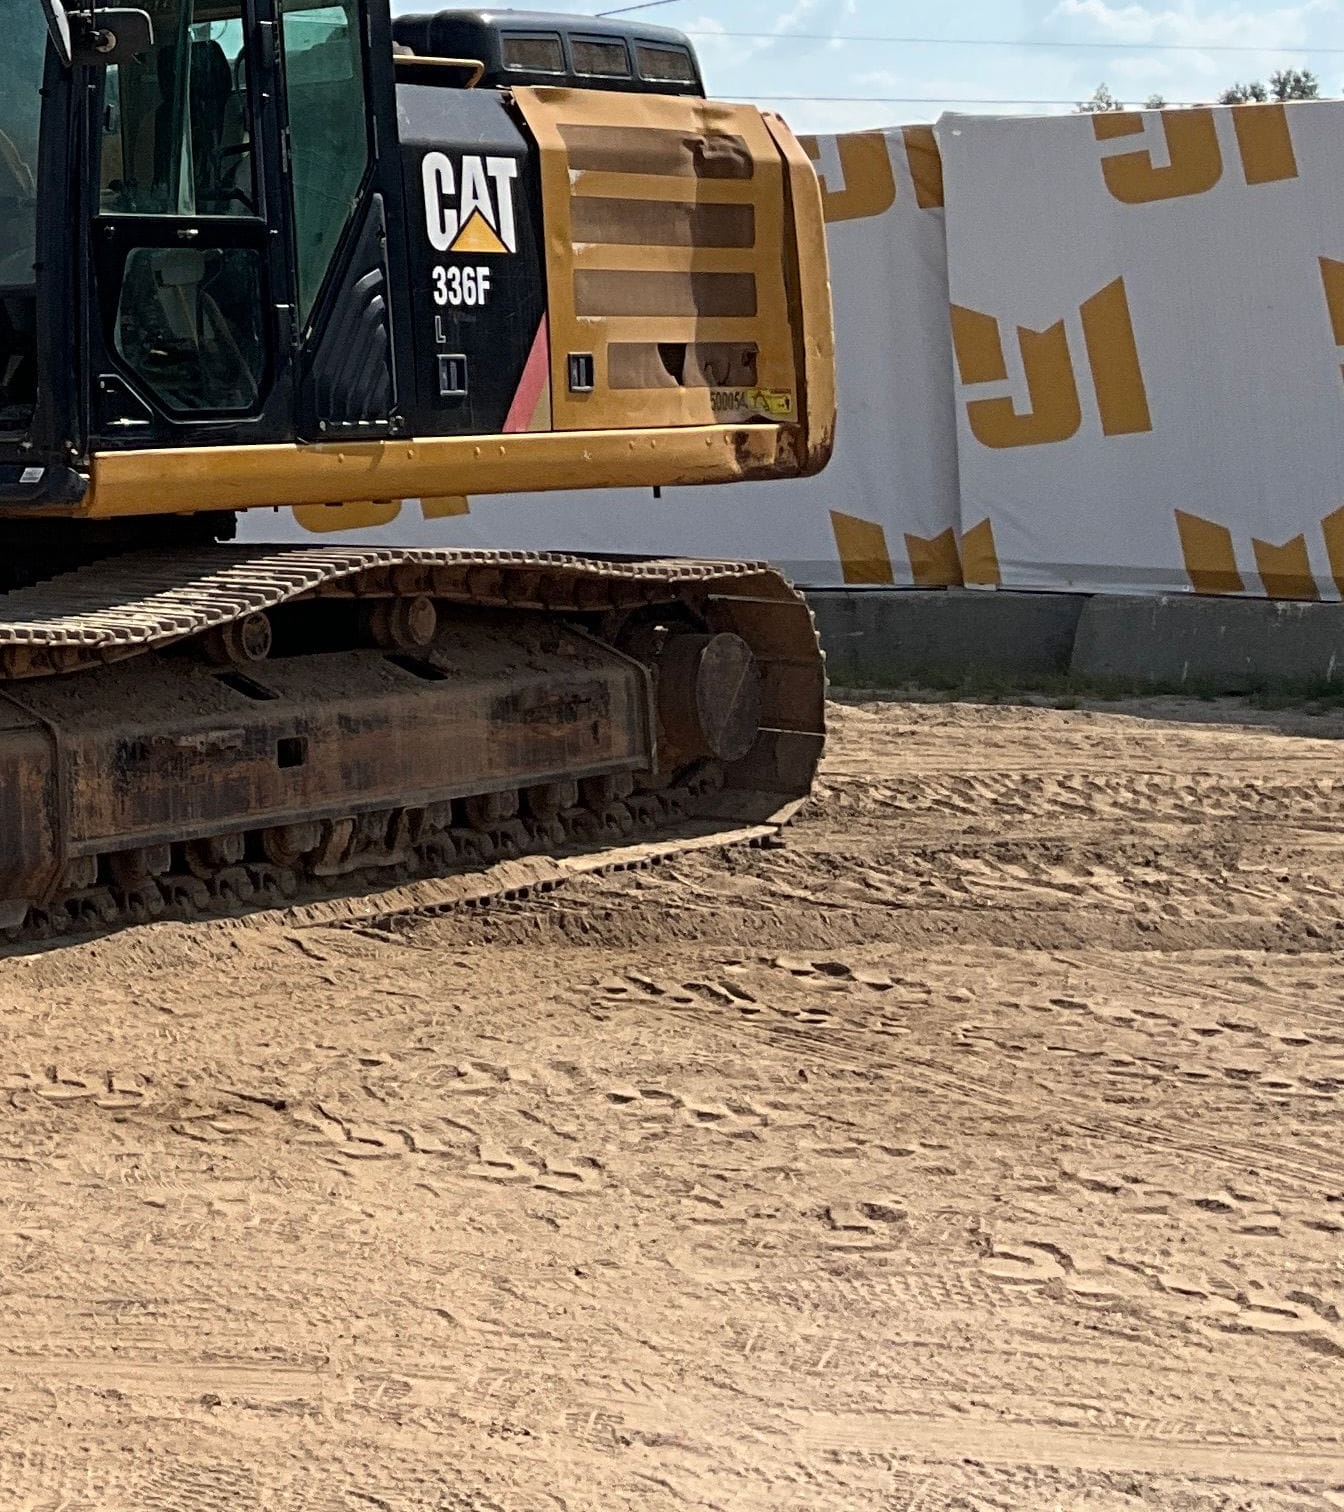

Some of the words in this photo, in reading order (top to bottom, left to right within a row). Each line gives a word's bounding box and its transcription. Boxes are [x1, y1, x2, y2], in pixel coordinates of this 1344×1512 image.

[421, 151, 518, 254] CAT
[432, 265, 491, 306] 336F
[434, 315, 447, 344] L
